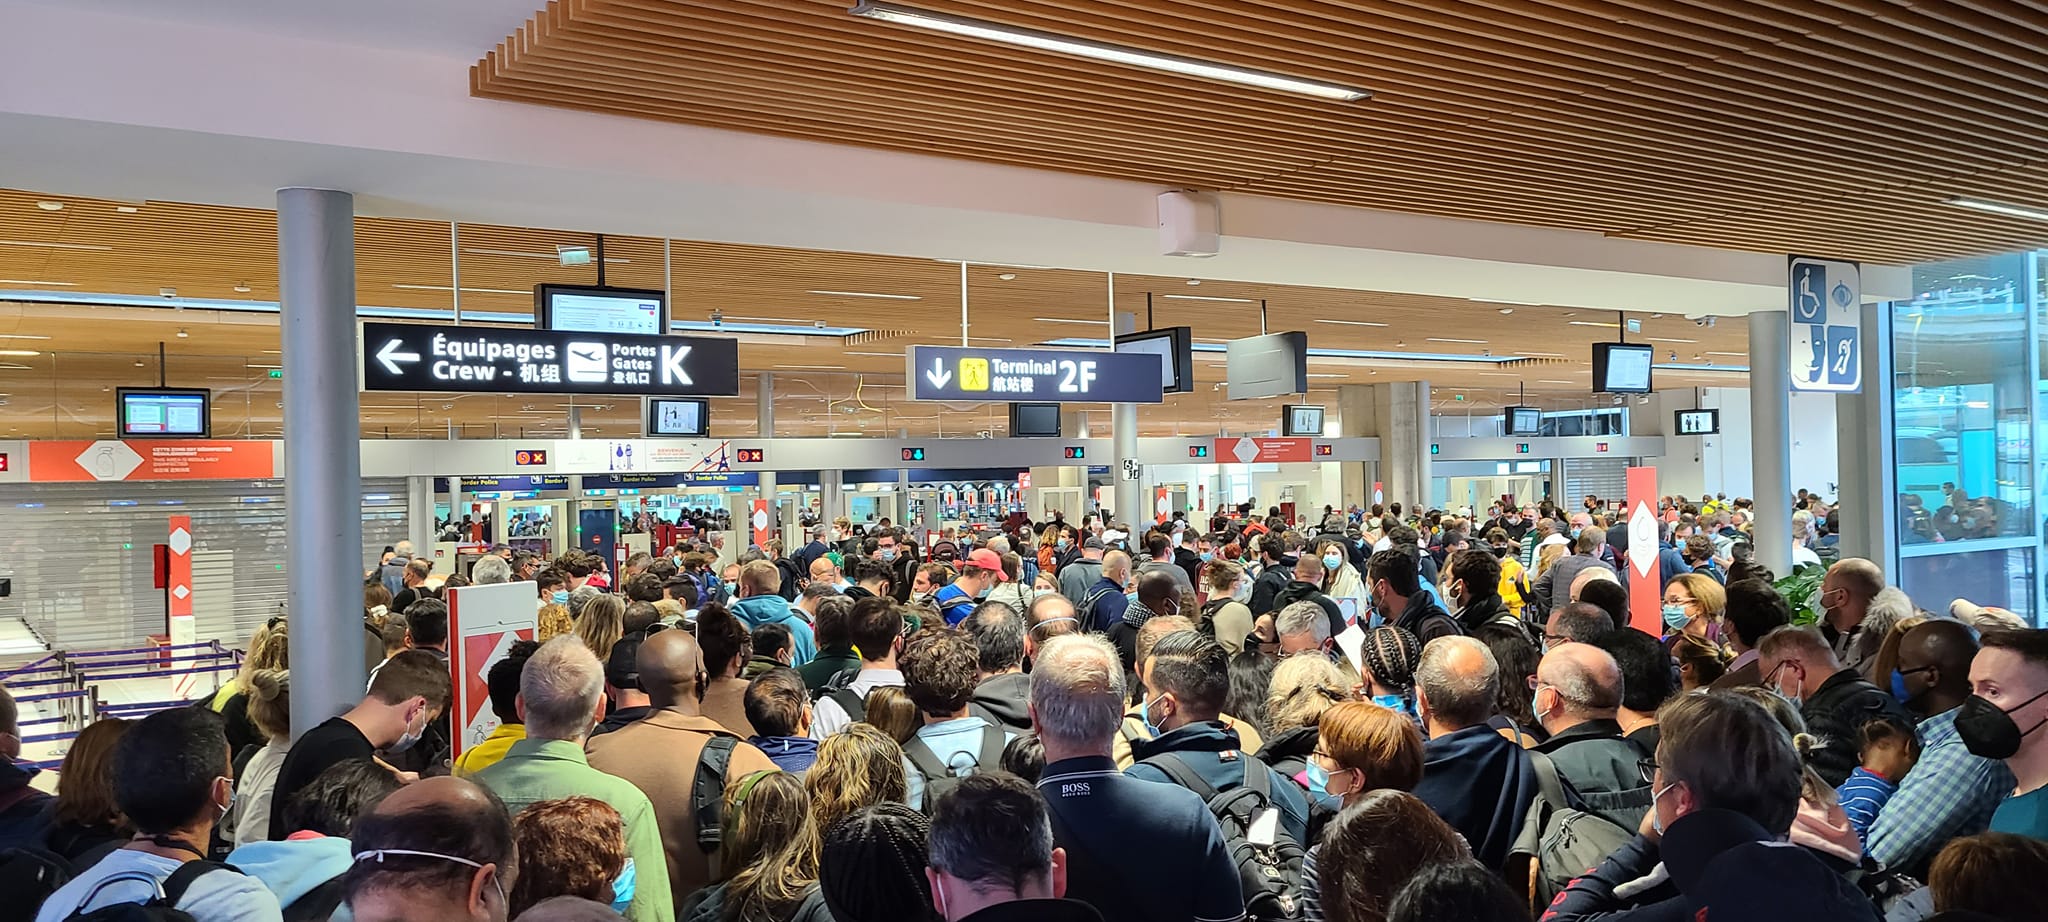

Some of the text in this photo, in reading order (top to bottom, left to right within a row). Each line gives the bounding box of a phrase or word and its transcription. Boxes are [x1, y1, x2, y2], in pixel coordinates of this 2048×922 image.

[433, 333, 556, 362] Équipages
[612, 343, 657, 357] Portes
[433, 360, 496, 380] Crew
[520, 363, 561, 383] 机组
[612, 357, 653, 370] Gates
[661, 345, 694, 385] K
[991, 358, 1057, 375] Terminal
[1059, 360, 1097, 393] 2F
[1062, 782, 1090, 794] BOSS
